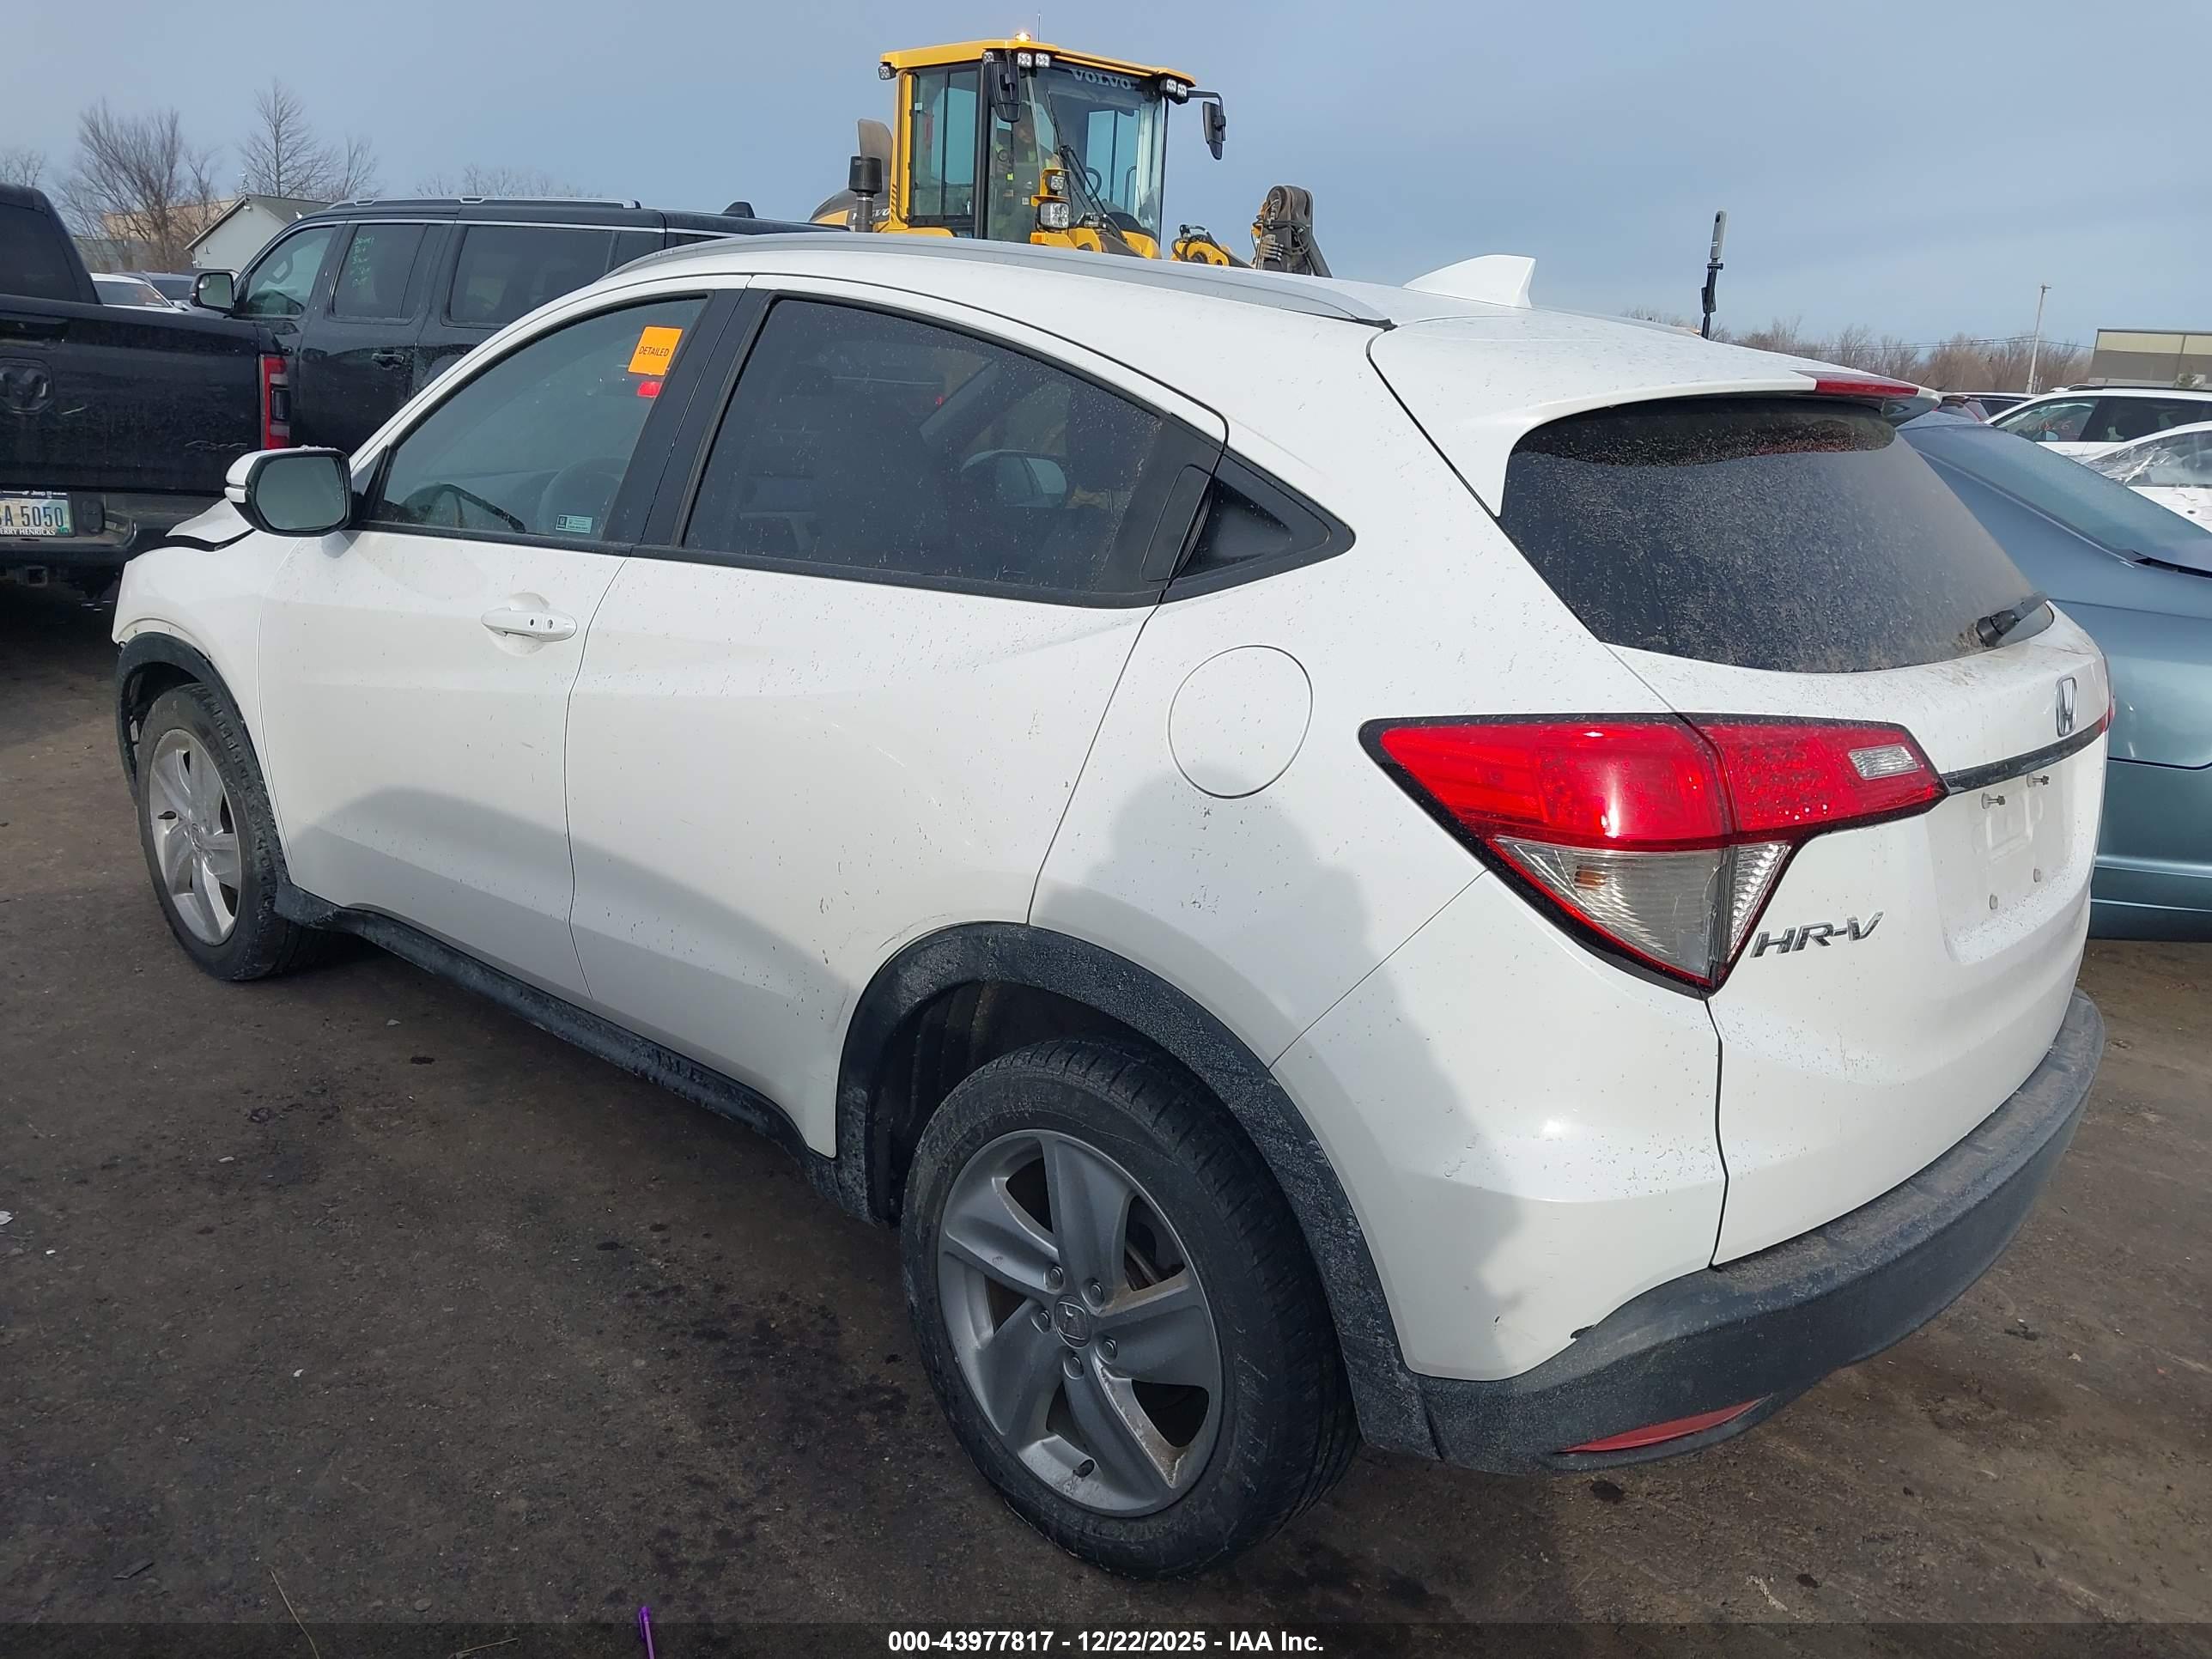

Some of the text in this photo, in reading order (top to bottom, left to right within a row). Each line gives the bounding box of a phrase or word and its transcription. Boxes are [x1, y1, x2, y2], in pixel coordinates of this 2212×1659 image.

[1069, 69, 1131, 89] VOLVO
[639, 346, 670, 356] DETAILED
[0, 505, 64, 528] A 5050
[1750, 911, 1884, 958] HR-V
